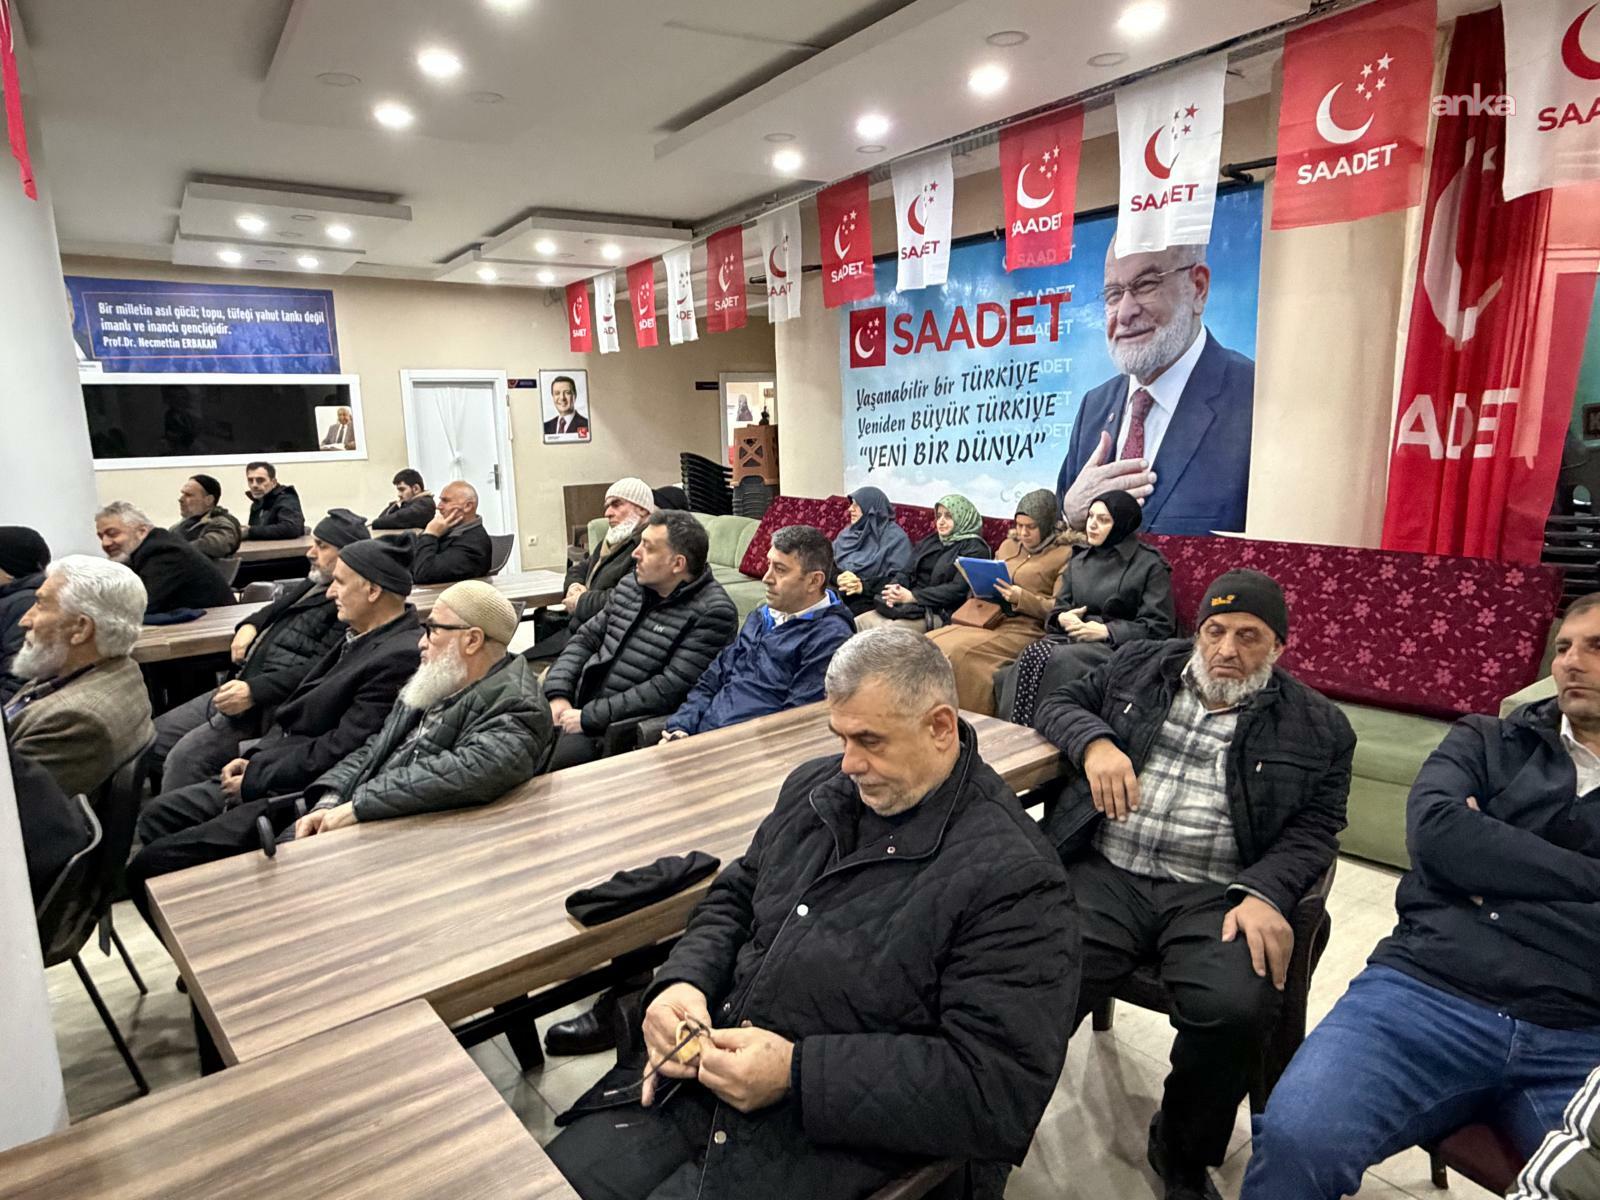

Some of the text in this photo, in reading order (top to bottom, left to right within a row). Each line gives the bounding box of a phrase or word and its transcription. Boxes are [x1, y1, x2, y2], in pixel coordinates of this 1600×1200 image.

[1537, 97, 1600, 132] SAA
[1296, 143, 1398, 185] SAADET
[98, 302, 325, 326] Bir milletin asıl gücü; topu, tüfeği yahut tankı değil
[133, 322, 145, 332] ve
[893, 291, 1072, 356] SAADET
[103, 336, 218, 349] Prof.Dr. Necmettin ERBAKAN
[856, 359, 1040, 411] Yaşanabilir bir TÜRKİYE
[857, 391, 1058, 440] Yeniden BÜYÜK TÜRKİYE
[913, 435, 949, 466] BİR
